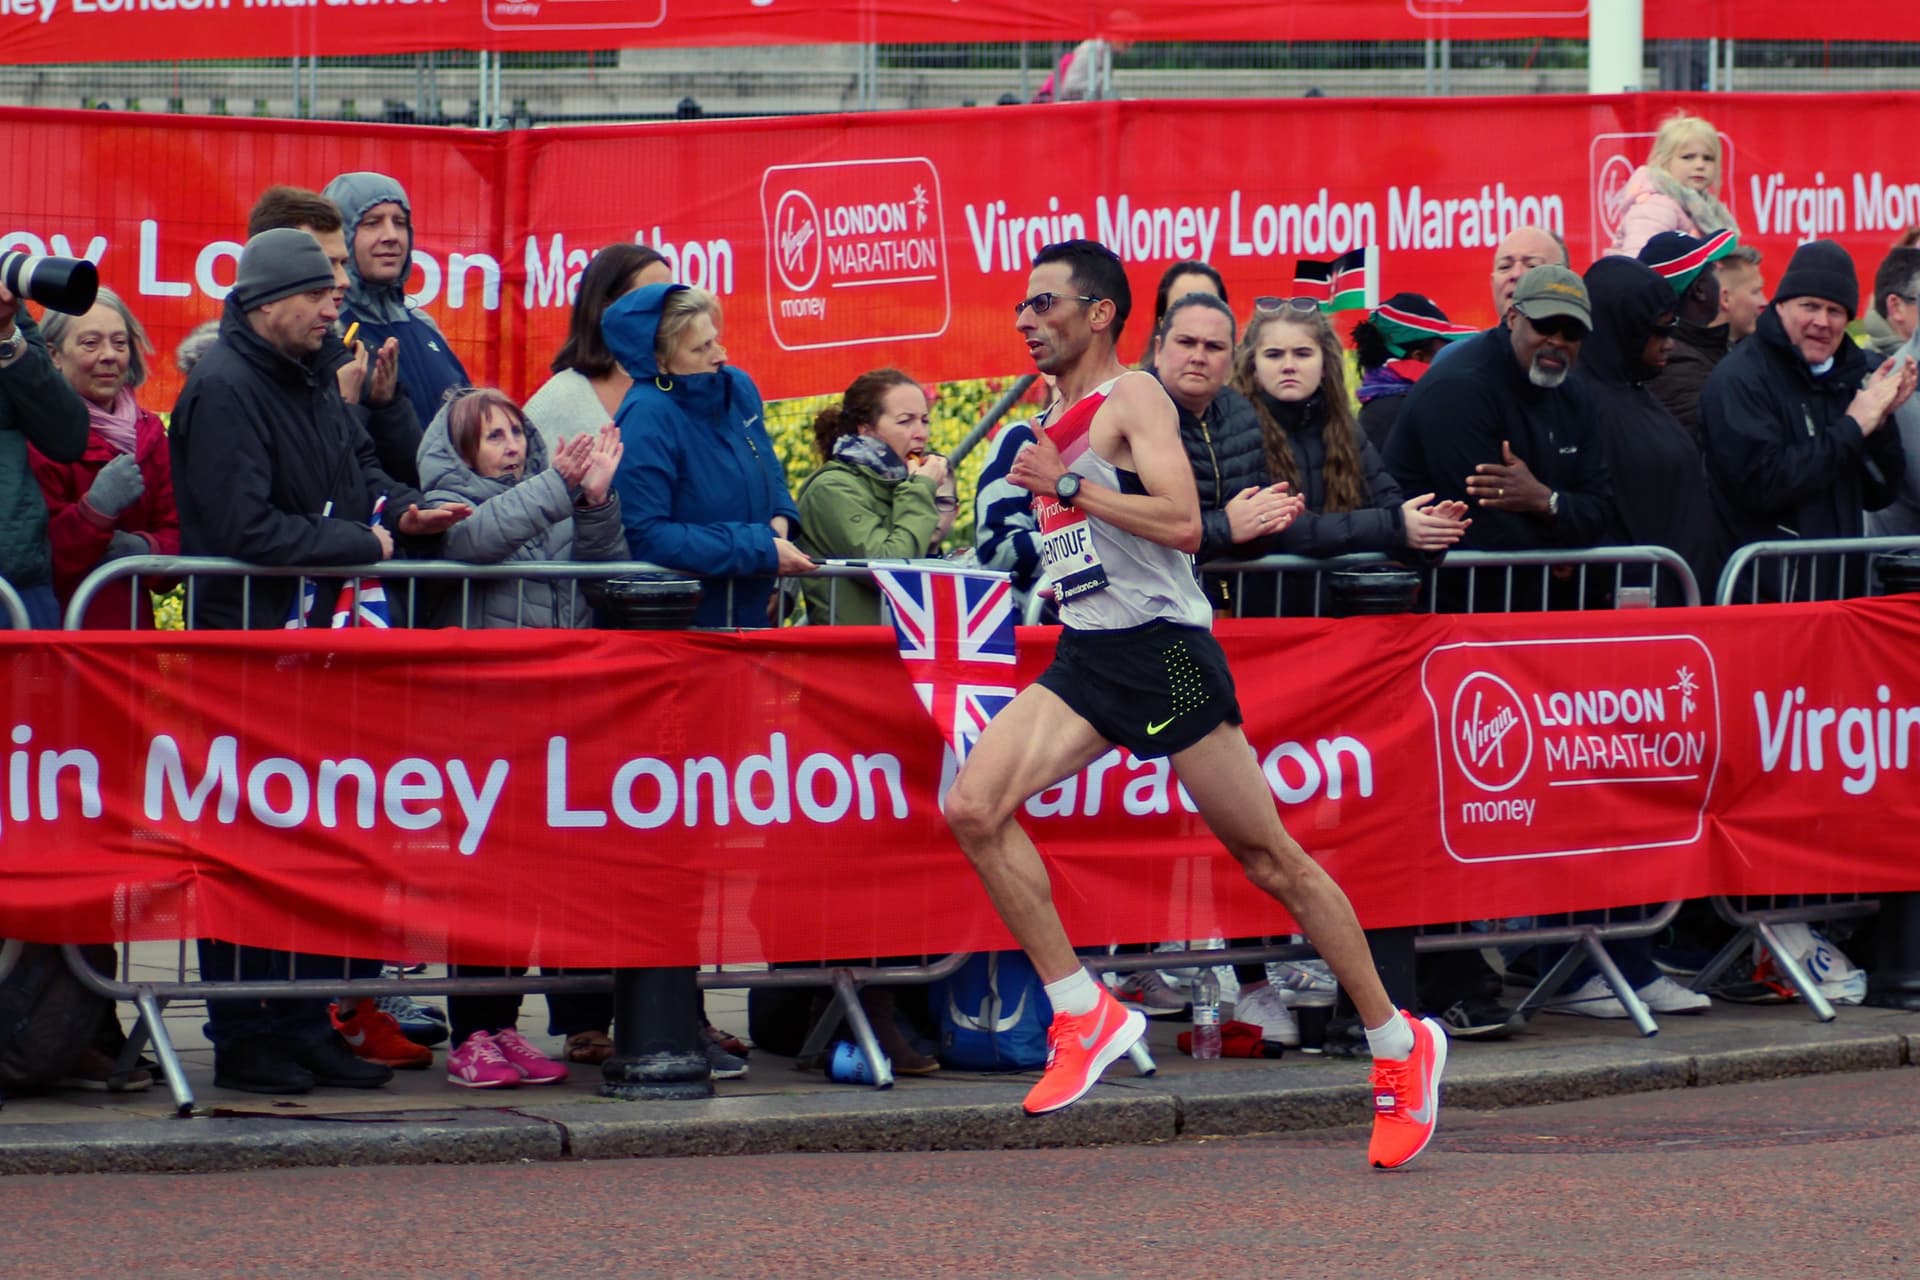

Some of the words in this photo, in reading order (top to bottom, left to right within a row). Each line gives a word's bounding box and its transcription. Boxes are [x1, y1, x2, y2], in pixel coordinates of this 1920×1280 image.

[824, 202, 907, 237] LONDON
[1096, 194, 1220, 263] Money
[1230, 188, 1376, 257] London
[1388, 182, 1564, 250] Marathon
[1751, 172, 1846, 247] Virgin
[139, 219, 500, 309] Loon
[524, 226, 733, 309] Mahon
[827, 238, 937, 275] MARATHON
[780, 297, 826, 320] money
[1533, 688, 1665, 726] LONDON
[1463, 691, 1518, 768] Virgin
[1544, 731, 1704, 772] MARATHON
[0, 725, 102, 822] in
[144, 734, 509, 855] Money
[547, 732, 909, 829] London
[938, 735, 1373, 818] araon
[1462, 799, 1536, 826] money
